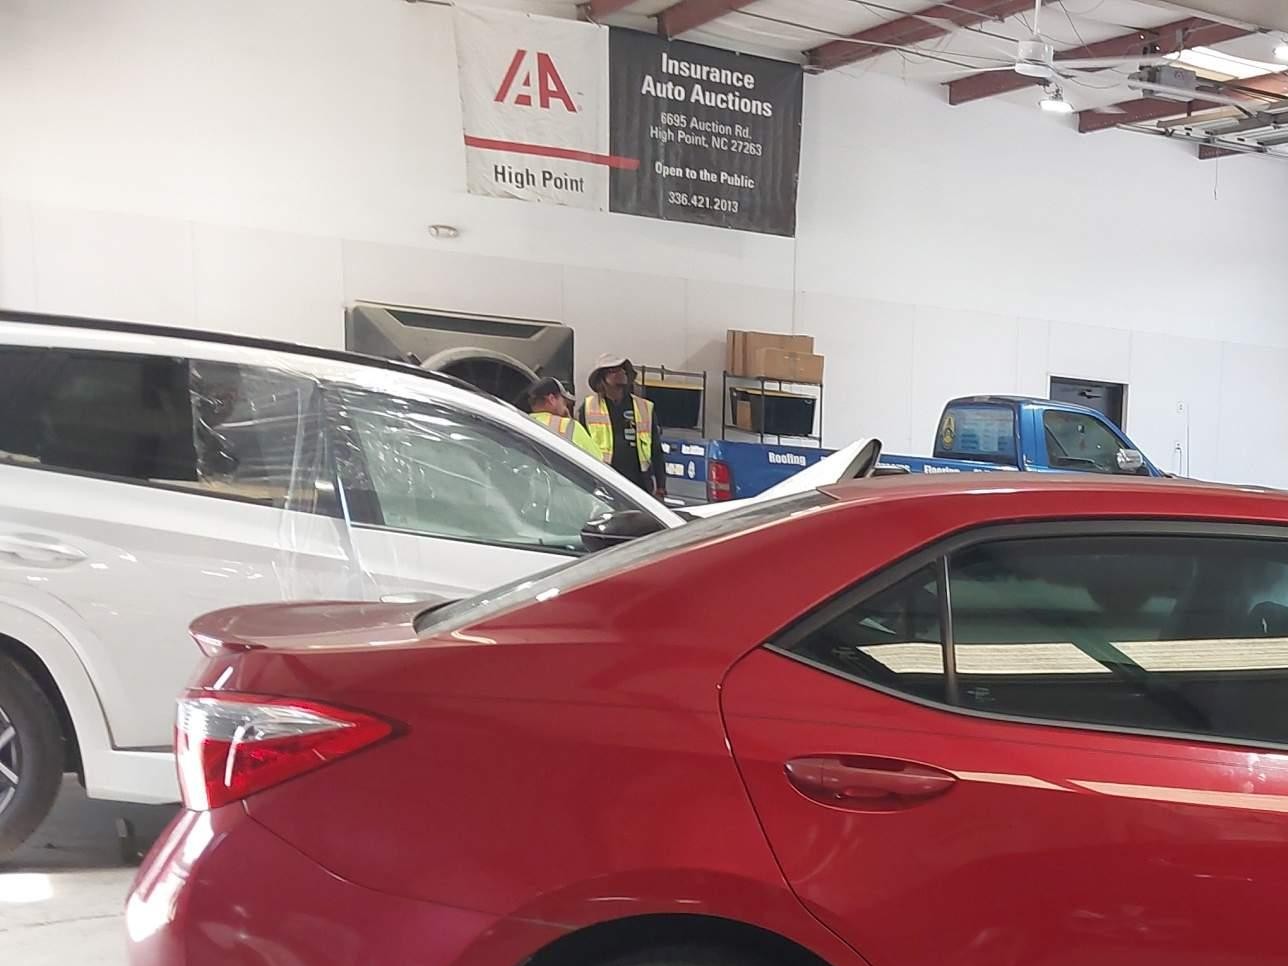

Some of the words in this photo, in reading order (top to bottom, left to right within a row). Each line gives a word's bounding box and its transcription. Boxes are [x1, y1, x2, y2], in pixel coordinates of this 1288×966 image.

[662, 52, 755, 89] Insurance
[641, 75, 686, 101] Auto
[690, 84, 773, 117] Auctions
[660, 112, 687, 128] 6695
[689, 117, 732, 135] Auction
[734, 124, 752, 139] Rd.
[649, 125, 674, 143] High
[711, 136, 729, 150] NC
[731, 140, 762, 156] 27263
[494, 164, 536, 189] High
[542, 170, 584, 193] Point
[655, 161, 683, 179] Open
[685, 167, 697, 180] to
[699, 168, 718, 183] the
[720, 171, 755, 189] Public
[668, 191, 739, 214] 336.421.2013
[768, 451, 806, 466] Roofing
